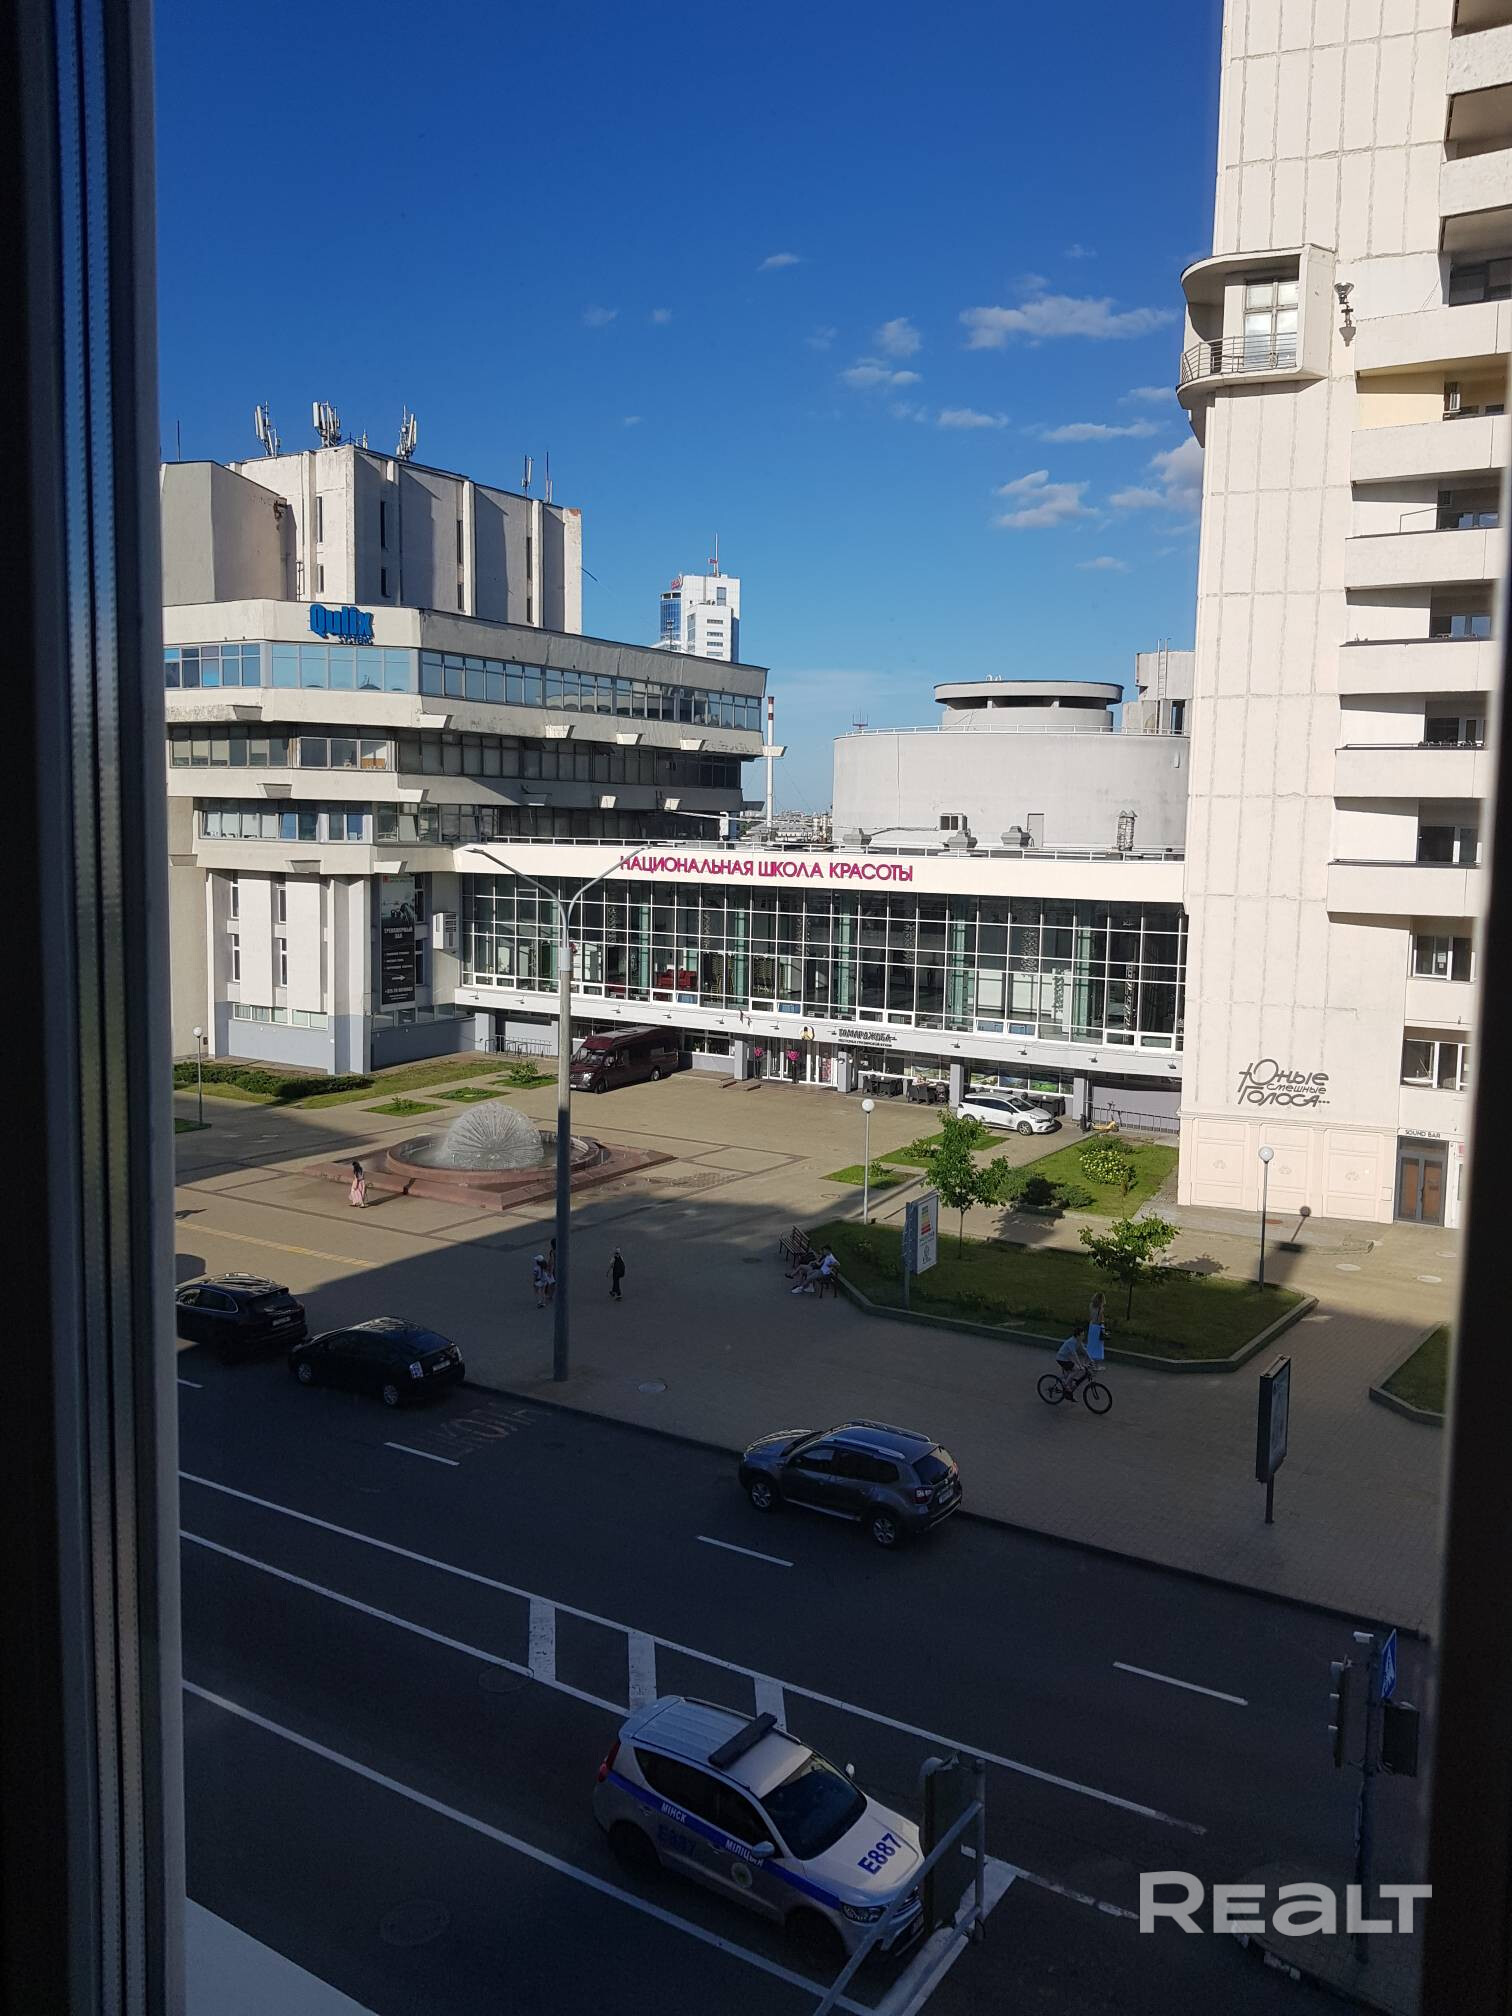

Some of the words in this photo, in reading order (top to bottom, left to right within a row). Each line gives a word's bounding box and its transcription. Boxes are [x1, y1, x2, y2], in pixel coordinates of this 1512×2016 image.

[310, 603, 375, 639] Qulix
[620, 856, 754, 876] НАЦИОНАЛЬНАЯ
[758, 861, 824, 879] ШКОЛА
[829, 862, 913, 882] КРАСОТЫ
[1237, 1058, 1330, 1093] Юные
[1266, 1083, 1327, 1095] смешные
[1404, 1129, 1427, 1138] SOUND
[1427, 1131, 1441, 1139] BAR
[661, 1802, 687, 1823] МІНСК
[857, 1832, 902, 1875] E887
